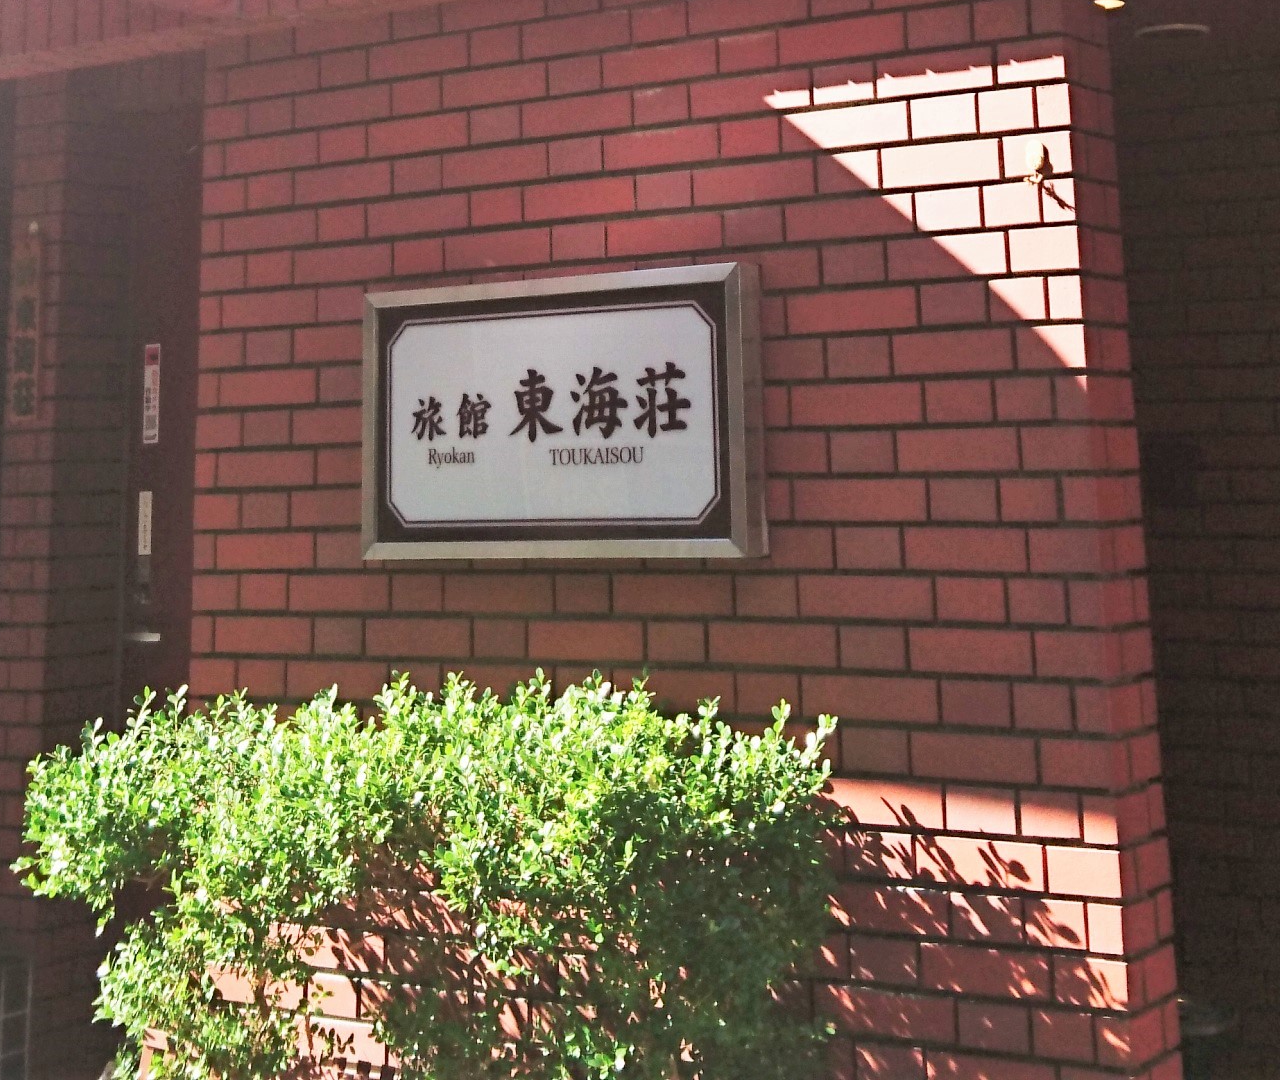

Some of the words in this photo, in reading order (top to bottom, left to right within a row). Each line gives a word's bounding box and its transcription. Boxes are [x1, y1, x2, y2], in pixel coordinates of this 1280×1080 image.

[411, 393, 492, 441] 旅館
[509, 362, 691, 442] 東海荘
[428, 446, 475, 470] Ryokan
[549, 446, 644, 466] TOUKAISOU
